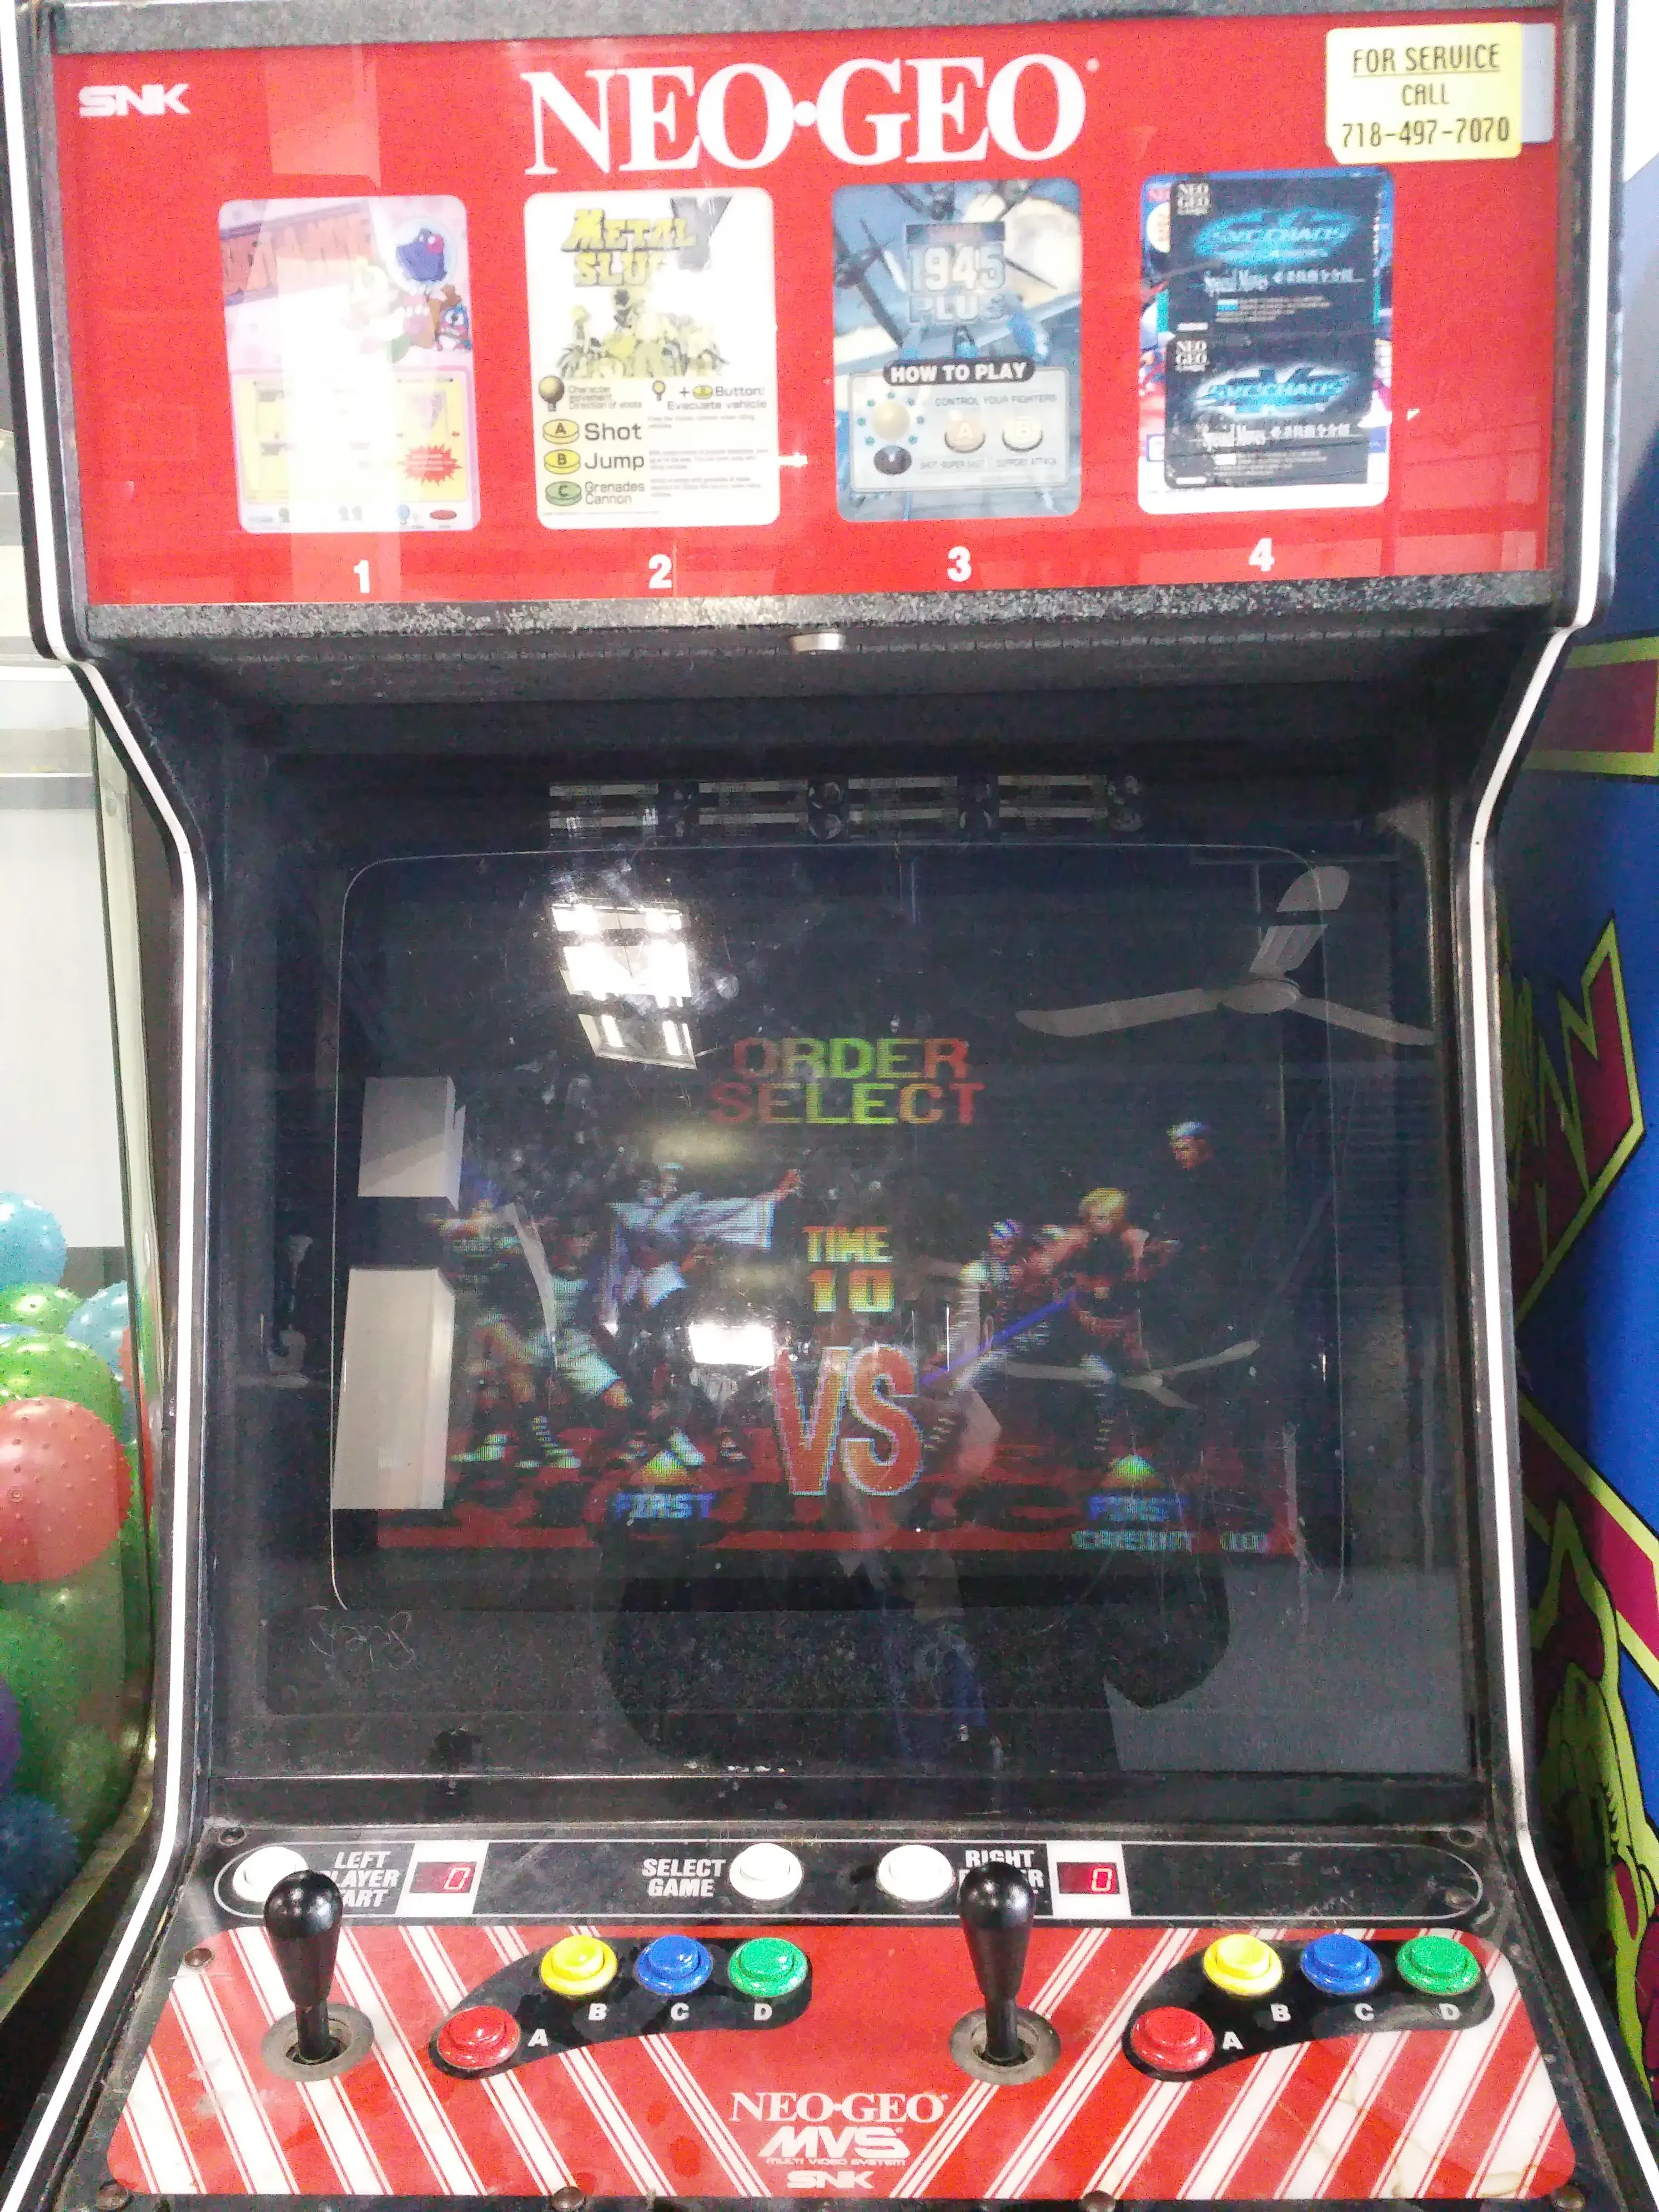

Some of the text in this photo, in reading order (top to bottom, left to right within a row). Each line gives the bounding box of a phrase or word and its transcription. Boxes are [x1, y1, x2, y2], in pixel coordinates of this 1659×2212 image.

[1353, 43, 1501, 73] FOR SERVICE
[79, 83, 190, 117] SNK
[1401, 83, 1450, 106] CALL
[1341, 115, 1510, 149] 718-497-7070
[561, 208, 697, 253] METAL
[573, 251, 666, 288] SLU
[908, 244, 1007, 292] 1945
[890, 362, 1027, 384] HOW TO PLAY
[726, 399, 767, 409] vehicle
[934, 396, 979, 406] CONTROL
[555, 422, 643, 441] A Shot
[557, 453, 567, 465] B
[584, 453, 645, 471] Jump
[558, 485, 569, 497] C
[585, 481, 645, 492] Grenades
[585, 492, 632, 505] Cannon
[947, 546, 972, 582] 3
[1248, 537, 1275, 572] 4
[354, 560, 370, 594] 1
[648, 554, 672, 589] 2
[732, 1037, 969, 1079] ORDER
[710, 1082, 985, 1124] SELECT
[802, 1225, 893, 1263] TIME
[808, 1269, 896, 1313] 10
[770, 1344, 924, 1496] VS
[334, 1851, 391, 1868] LEFT
[642, 1858, 726, 1877] SELECT
[965, 1849, 1035, 1868] RIGHT
[443, 1866, 470, 1892] 0
[647, 1878, 716, 1898] GAME
[1091, 1867, 1113, 1892] 0
[340, 1889, 389, 1907] ART
[589, 2003, 607, 2022] B
[670, 2003, 690, 2022] C
[753, 2003, 773, 2022] D
[1270, 2003, 1291, 2022] B
[1354, 2003, 1375, 2021] C
[1440, 2003, 1460, 2021] D
[527, 2028, 549, 2048] A
[1221, 2031, 1244, 2050] A
[757, 2125, 911, 2159] MVS
[786, 2170, 874, 2189] SNK
